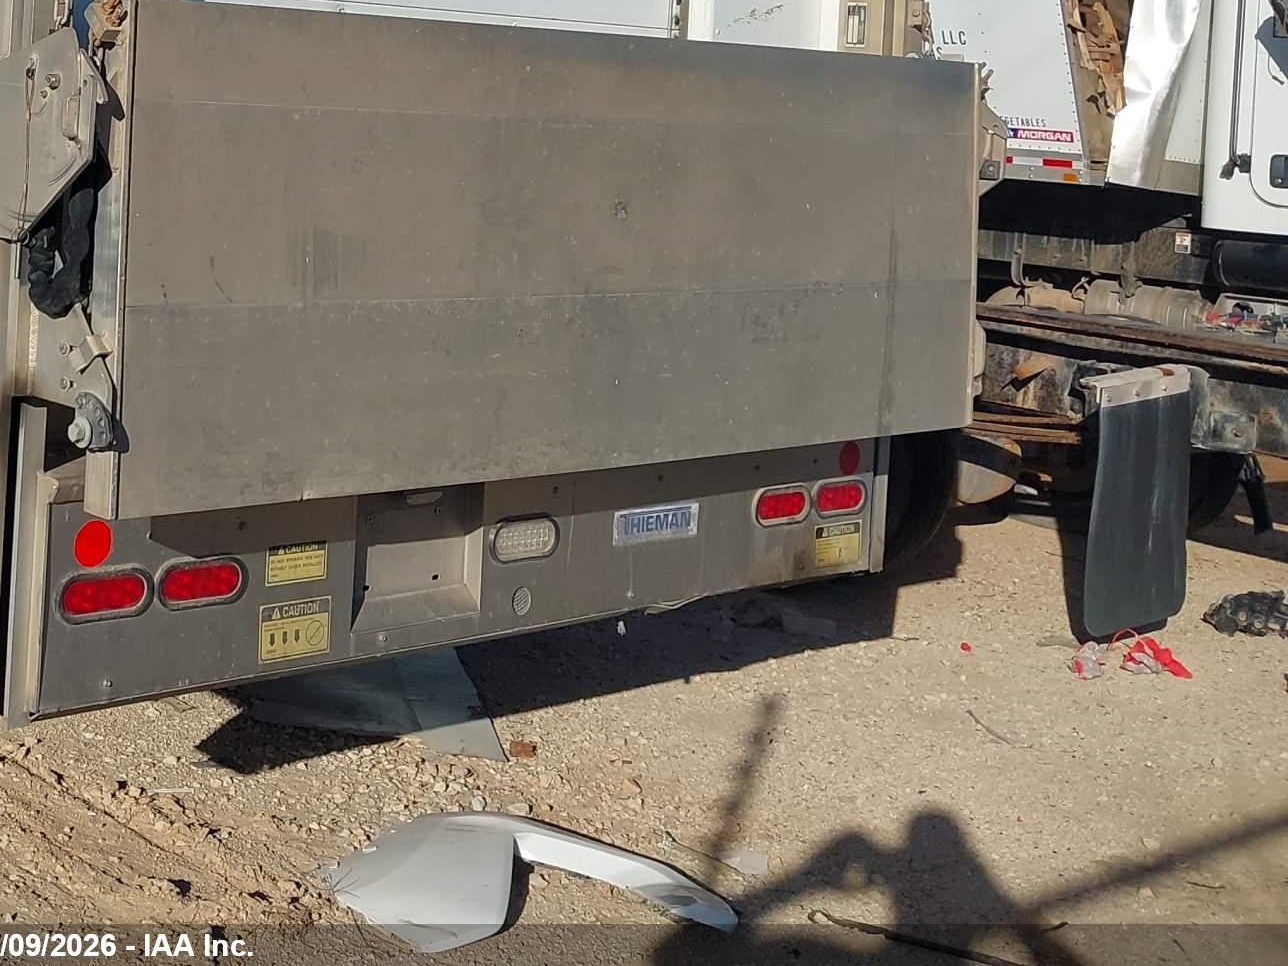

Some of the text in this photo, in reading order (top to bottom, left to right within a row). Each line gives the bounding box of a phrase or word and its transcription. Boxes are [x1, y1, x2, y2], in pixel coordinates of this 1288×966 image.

[941, 30, 967, 45] LLC
[1000, 115, 1047, 128] EGETABLES
[1017, 130, 1071, 141] MORGAN
[283, 601, 319, 617] CAUTION
